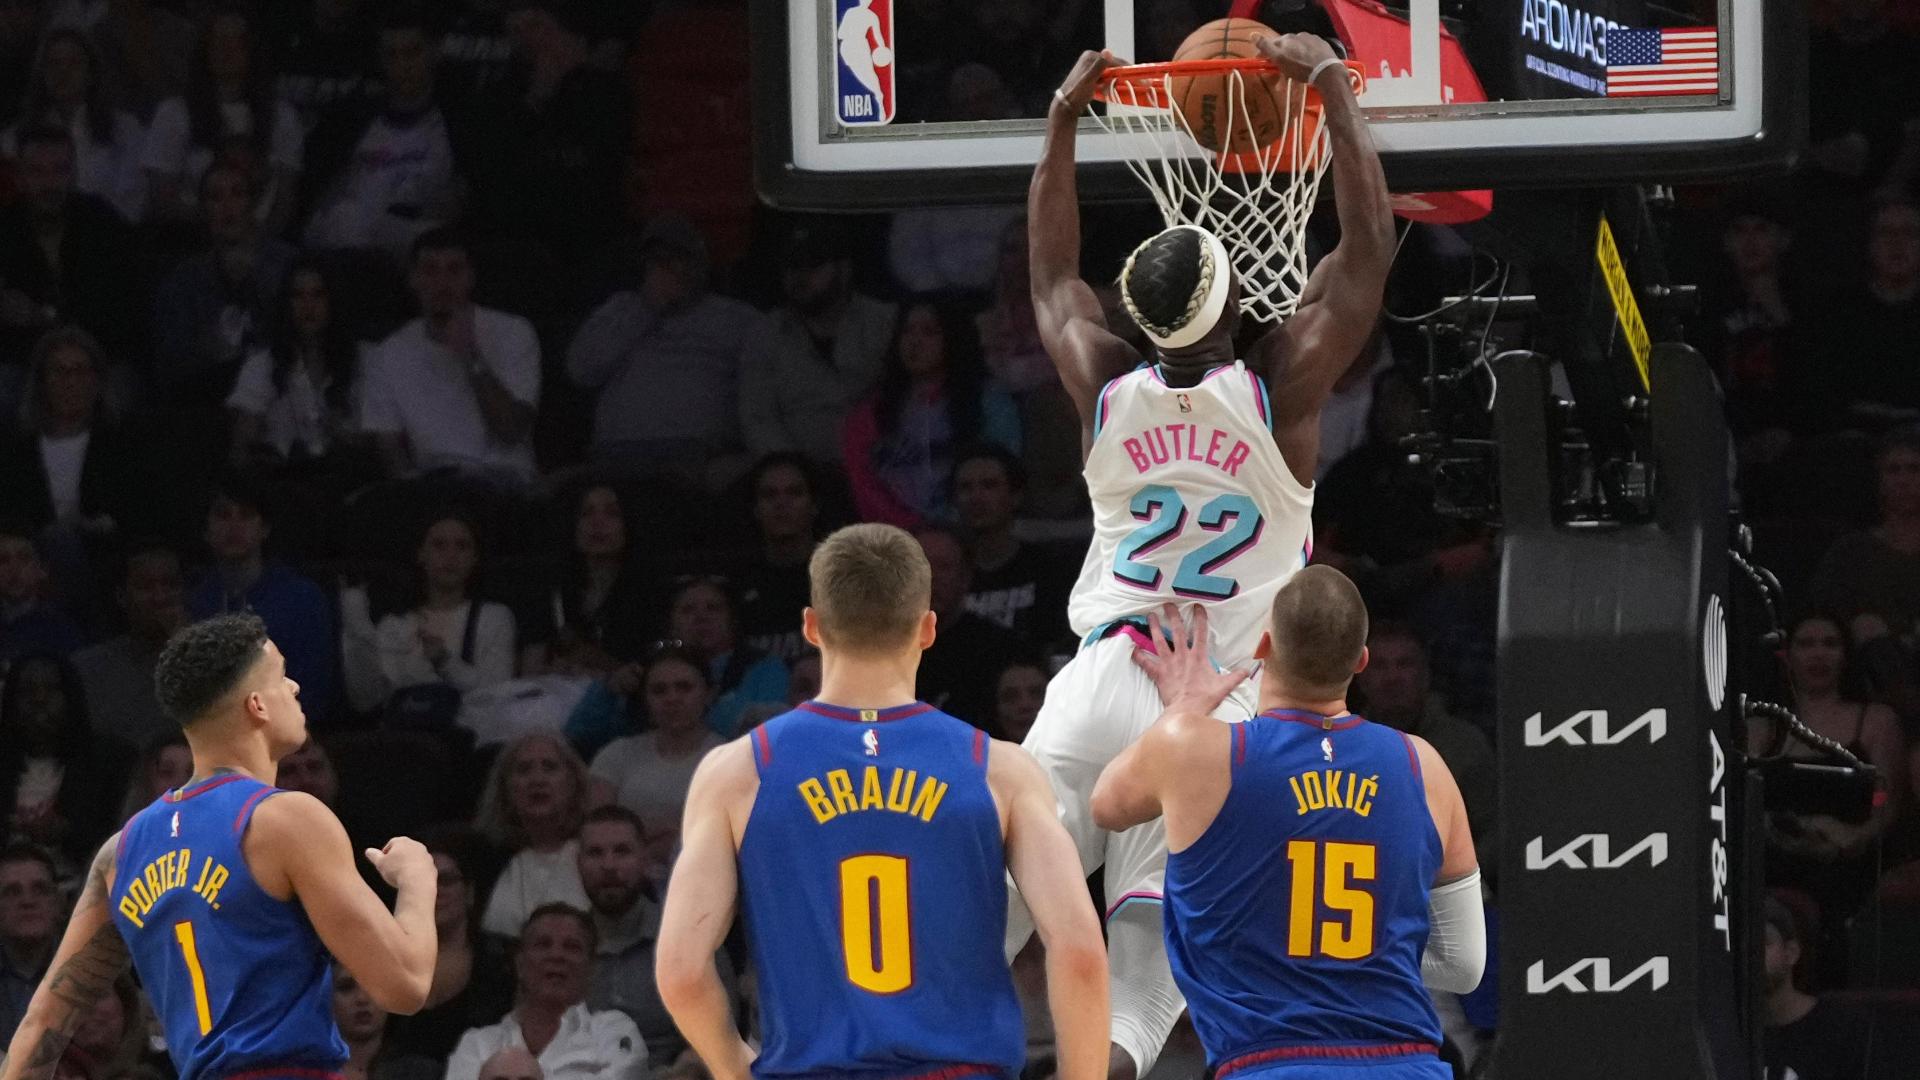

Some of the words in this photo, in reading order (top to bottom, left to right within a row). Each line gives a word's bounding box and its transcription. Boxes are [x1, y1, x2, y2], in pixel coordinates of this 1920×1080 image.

[1521, 0, 1630, 67] AROMA3
[844, 94, 873, 117] NBA
[1122, 424, 1251, 477] BUTLER
[1112, 484, 1266, 602] 22
[1524, 708, 1667, 747] KIA
[798, 766, 948, 824] BRAUN
[1288, 771, 1379, 818] JOKIĆ
[1526, 832, 1669, 870] KIA
[1709, 729, 1730, 951] AT&T
[119, 848, 191, 928] PORTER
[192, 856, 230, 911] JR.
[1286, 840, 1376, 960] 15
[839, 853, 913, 995] 0
[175, 920, 213, 1037] 1
[1527, 956, 1670, 994] KIA
